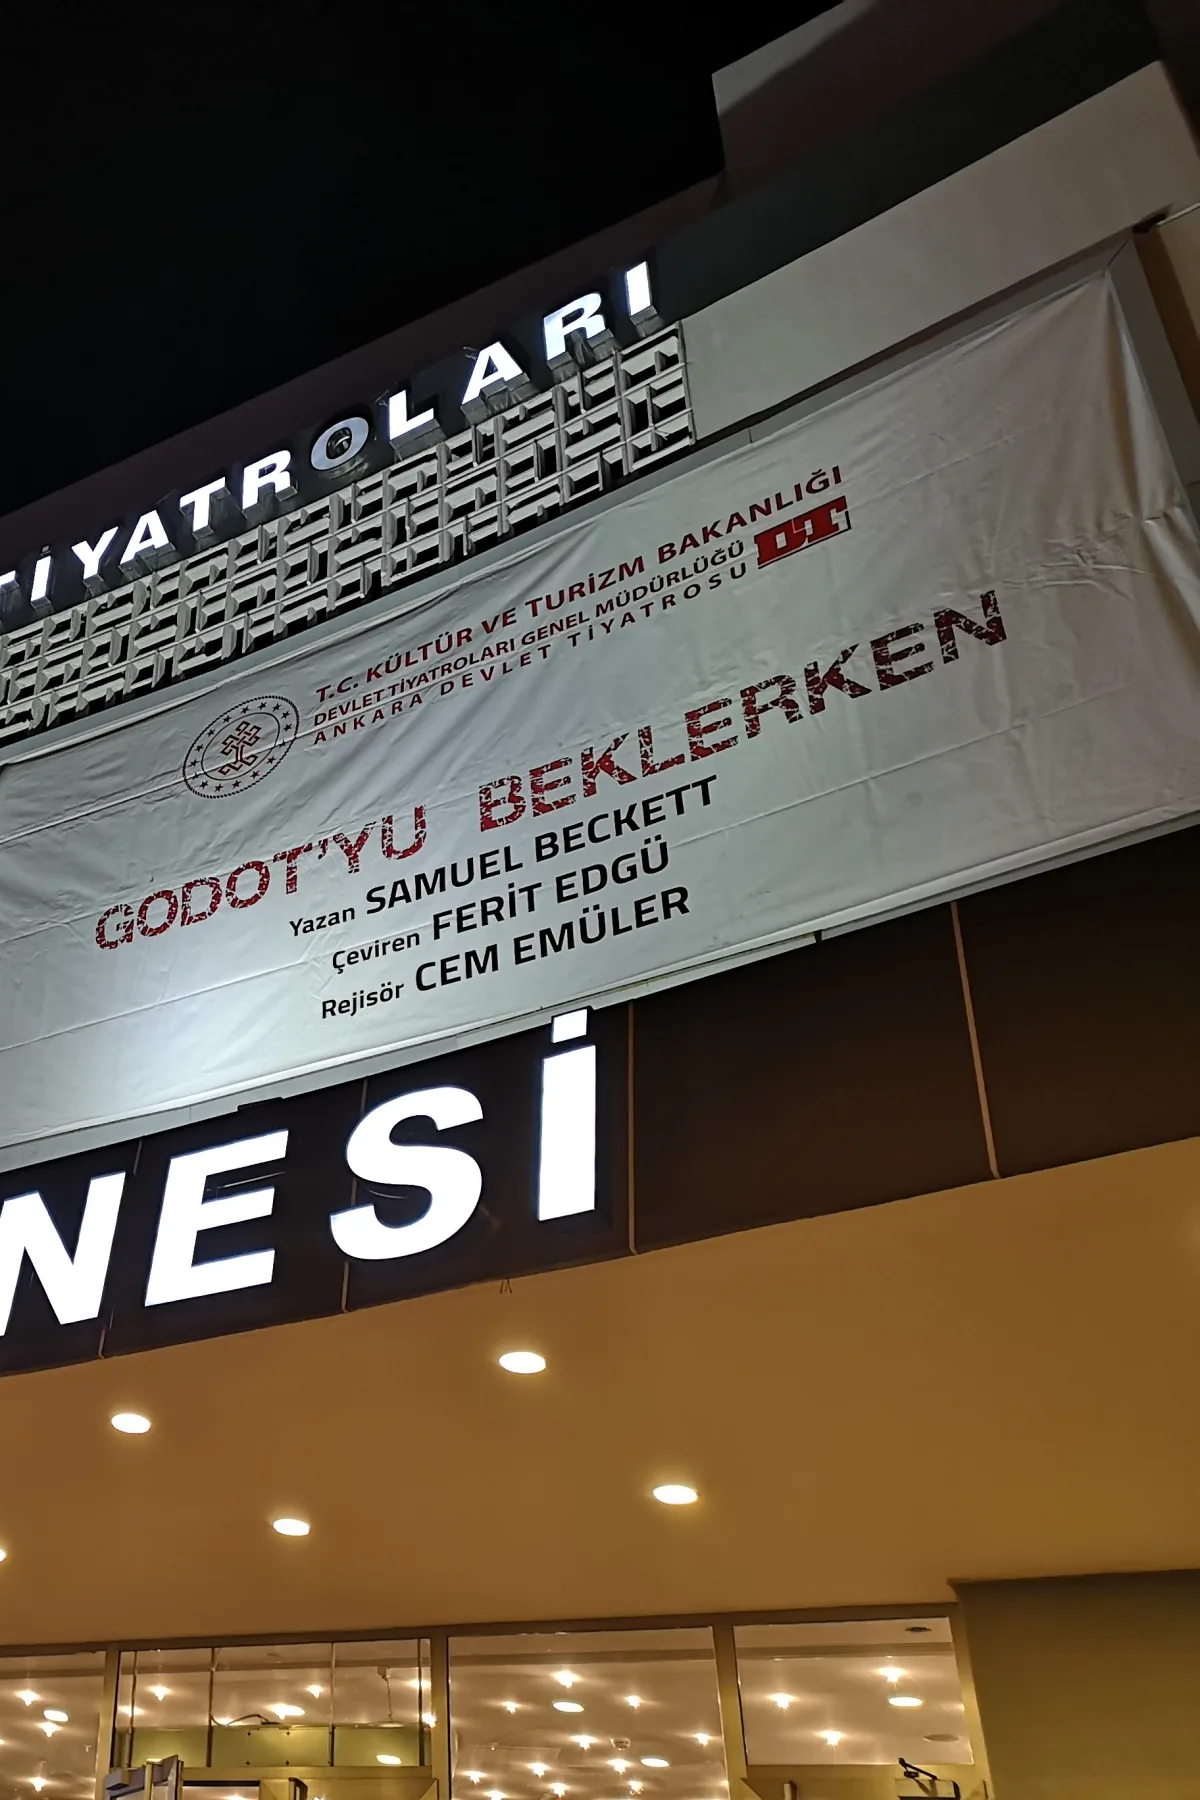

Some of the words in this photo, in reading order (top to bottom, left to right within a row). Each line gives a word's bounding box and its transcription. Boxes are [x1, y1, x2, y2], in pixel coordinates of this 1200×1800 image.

[314, 689, 385, 727] DEVLET
[387, 640, 516, 695] TİYATROLARI
[521, 610, 590, 646] GENEL
[595, 539, 745, 618] MÜDÜRLÜĞÜ
[314, 694, 424, 745] ANKARA
[440, 645, 552, 697] DEVLET
[567, 562, 747, 648] TİYATROSU
[316, 675, 359, 703] T.C.
[366, 627, 473, 683] KÜLTÜR
[480, 606, 518, 634] VE
[524, 555, 646, 617] TURİZM
[657, 465, 843, 564] BAKANLIĞI
[95, 804, 428, 950] GODOT'YU
[478, 589, 1008, 833] BEKLERKEN
[289, 907, 356, 938] Yazan
[366, 845, 524, 916] SAMUEL
[536, 775, 718, 863] BECKETT
[321, 983, 405, 1019] Rejisör
[415, 943, 500, 992] CEM
[513, 886, 691, 965] EMÜLER
[332, 932, 421, 974] Çeviren
[433, 881, 545, 941] FERİT
[556, 834, 671, 904] EDGÜ
